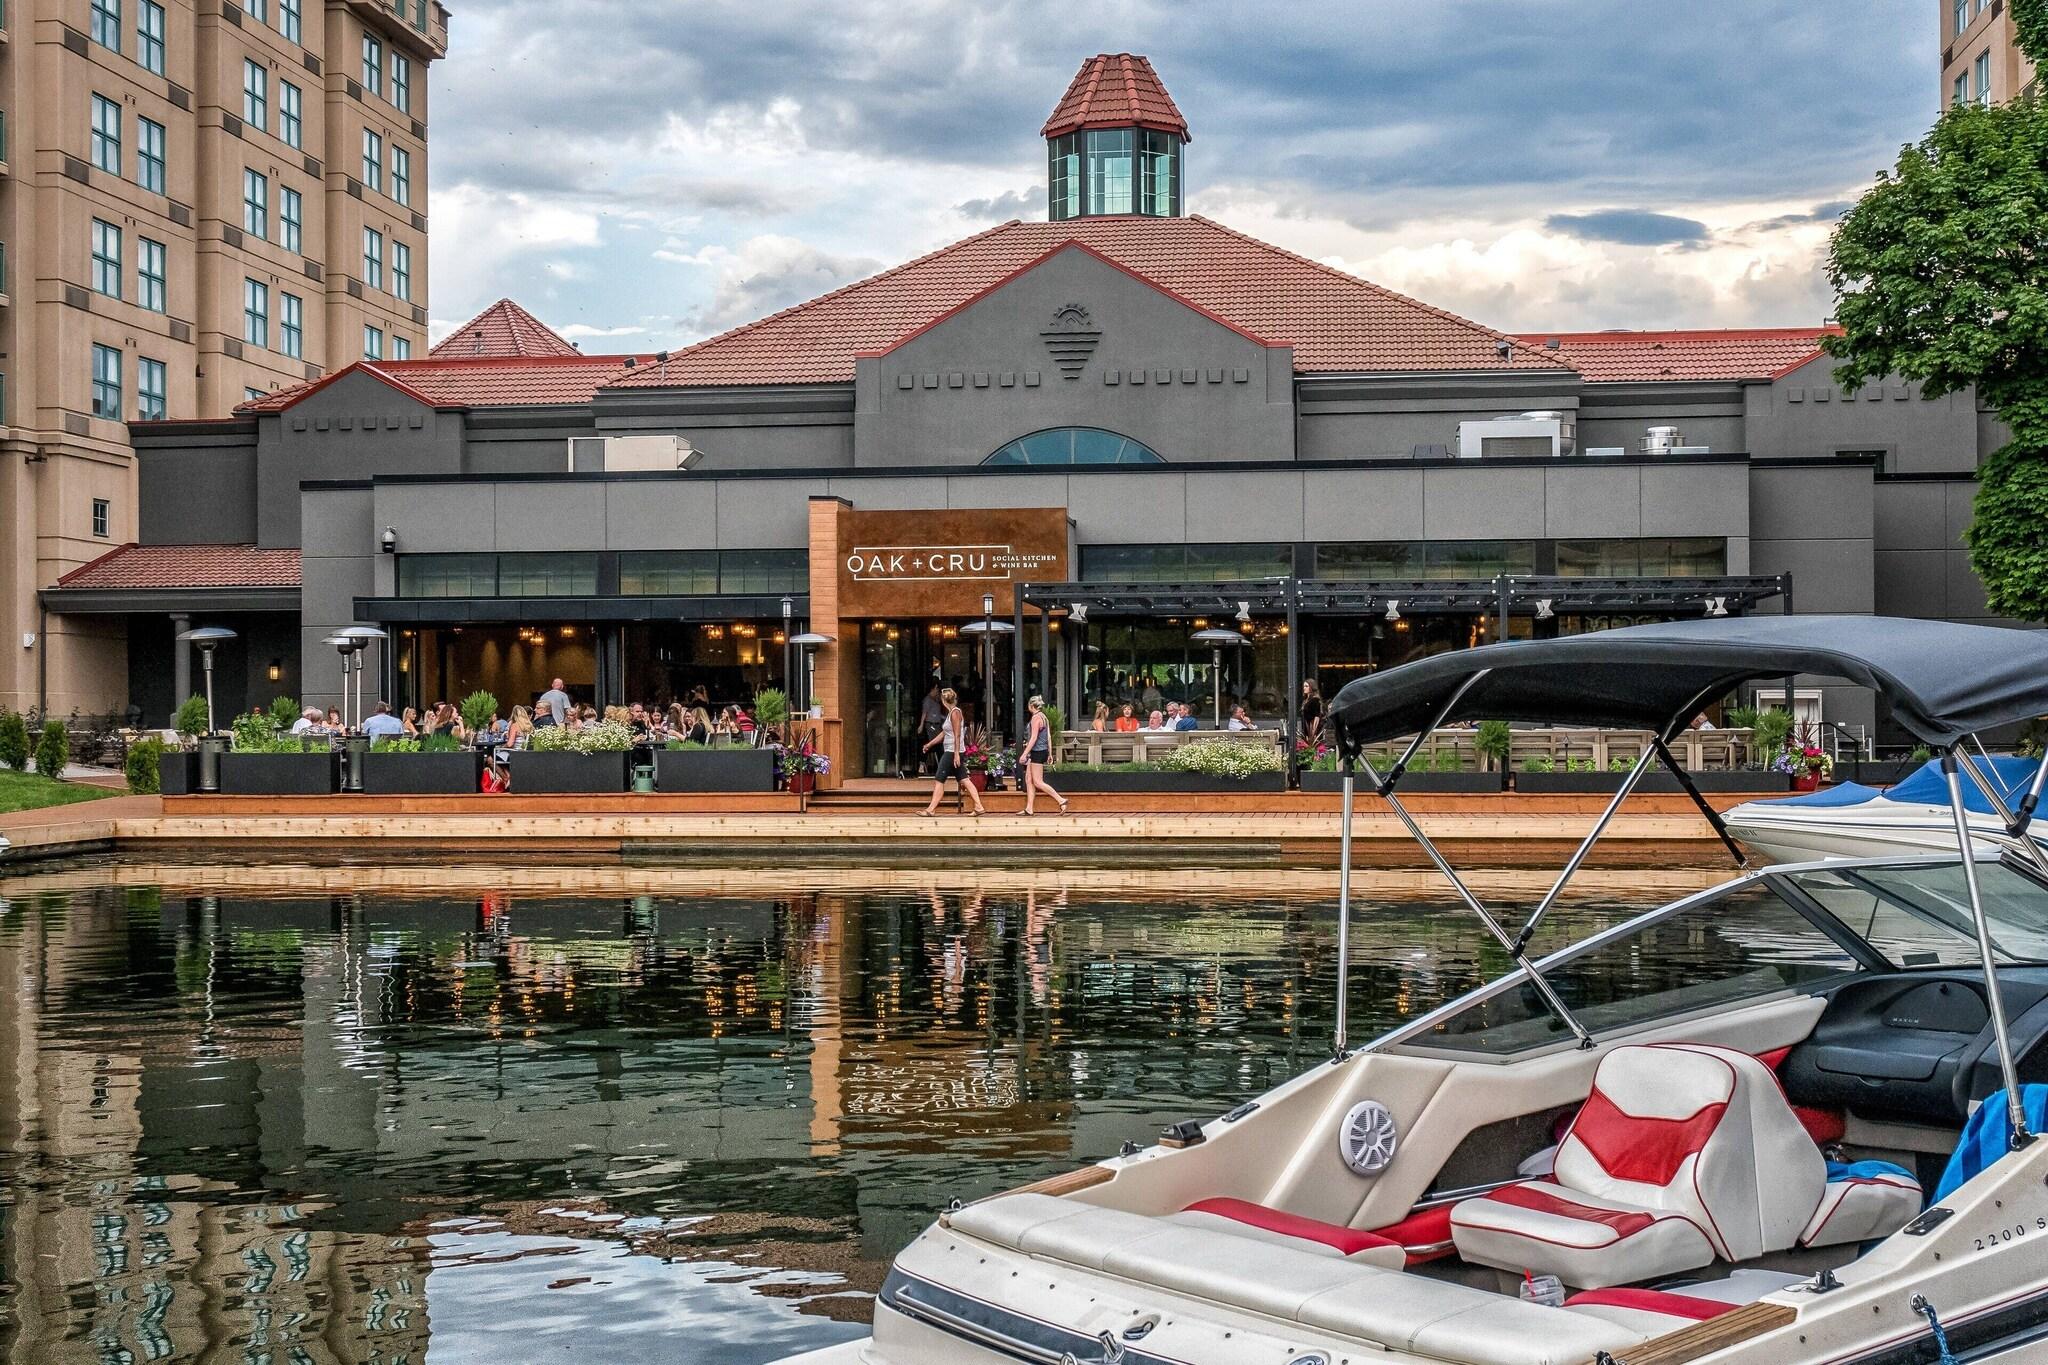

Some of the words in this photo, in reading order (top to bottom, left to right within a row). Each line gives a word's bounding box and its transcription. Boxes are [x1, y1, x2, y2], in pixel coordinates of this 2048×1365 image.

[846, 554, 905, 573] OAK
[912, 558, 923, 569] +
[929, 553, 984, 572] CRU
[1974, 1224, 2025, 1251] 2200
